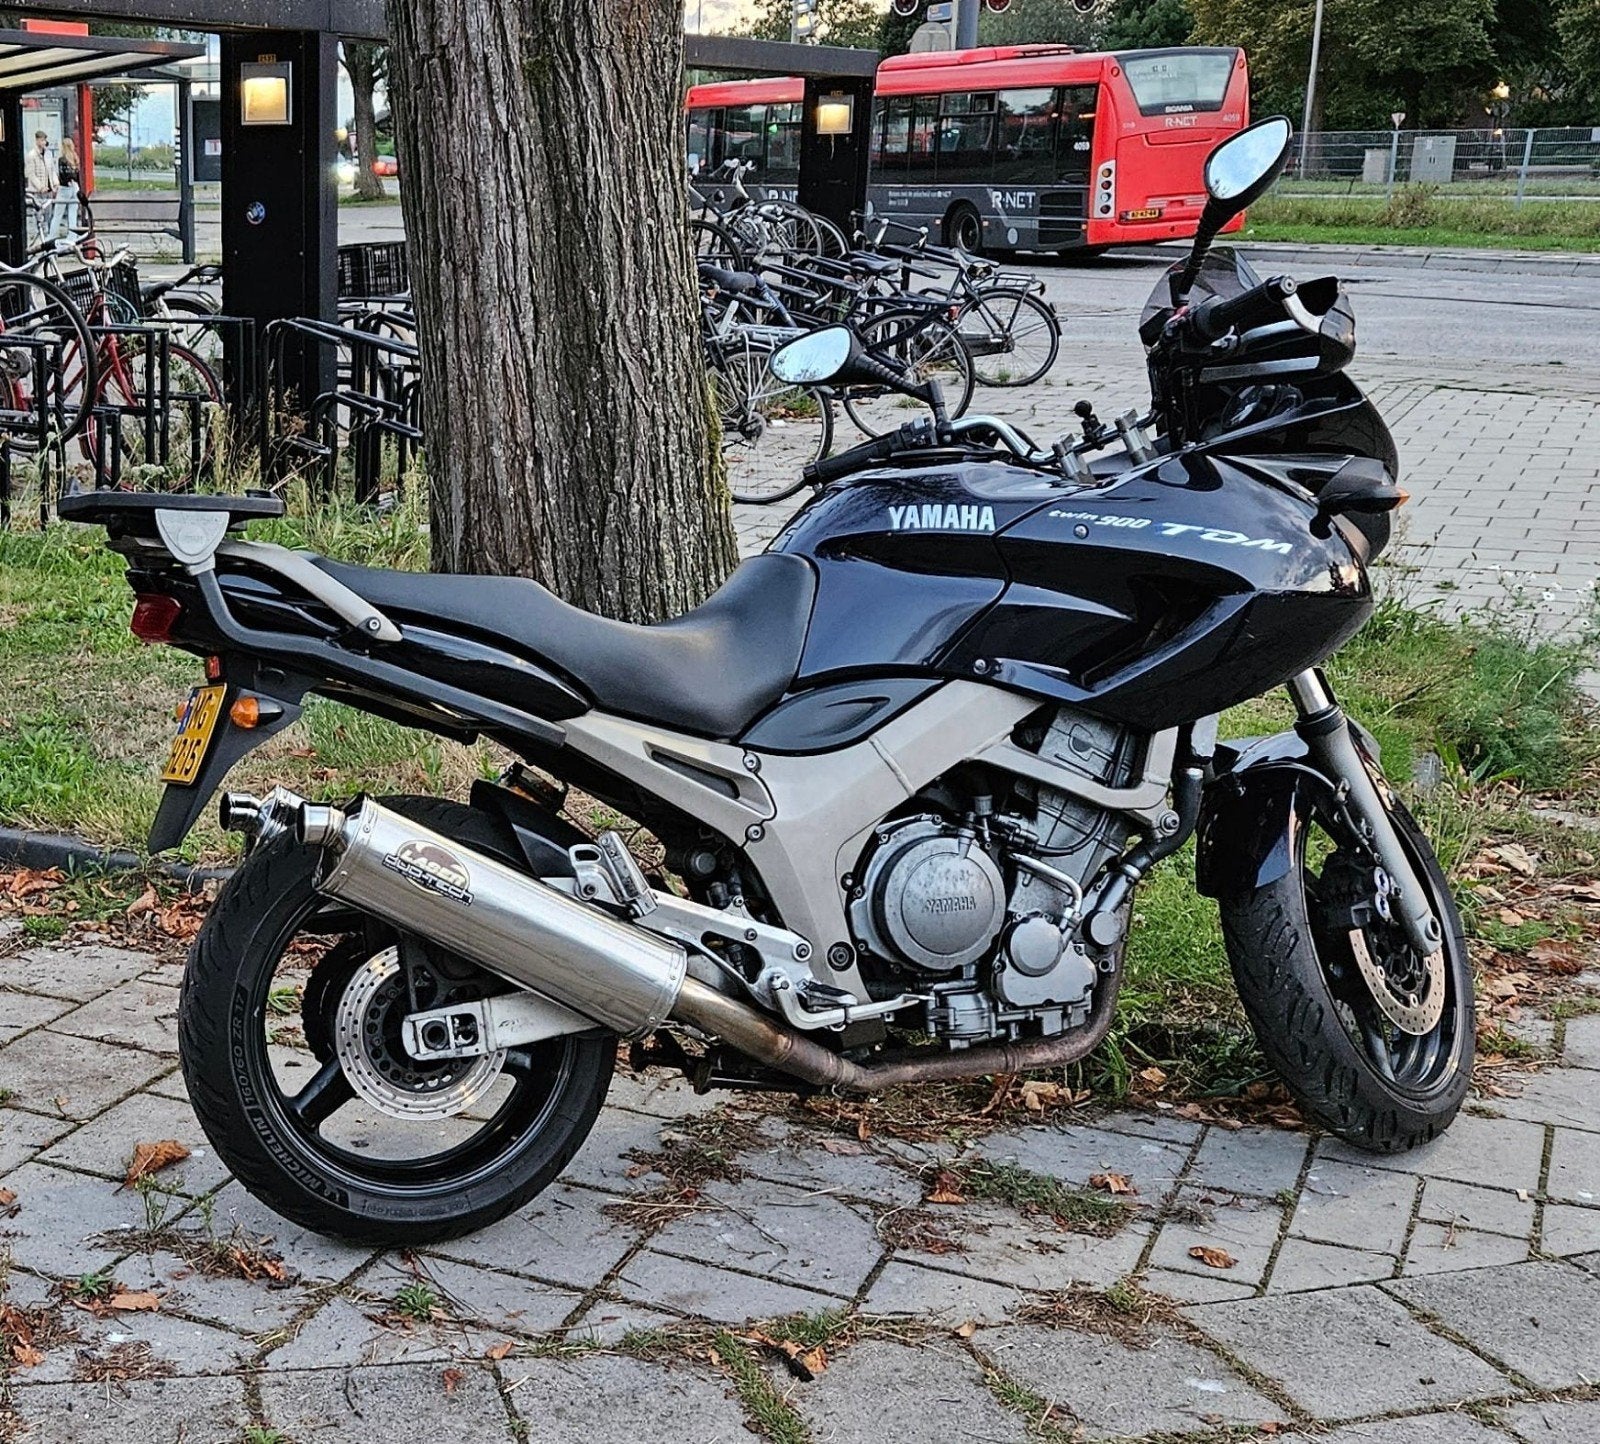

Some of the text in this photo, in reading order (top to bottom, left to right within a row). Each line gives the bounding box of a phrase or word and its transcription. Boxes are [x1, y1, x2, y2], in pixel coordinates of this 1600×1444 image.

[888, 503, 996, 531] YAMAHA
[1095, 515, 1151, 529] 900
[1160, 522, 1293, 554] TDM
[926, 896, 976, 914] YAMAHA
[233, 1017, 242, 1040] ZR
[233, 1045, 255, 1104] 160/60
[253, 1116, 322, 1191] MICHELIN
